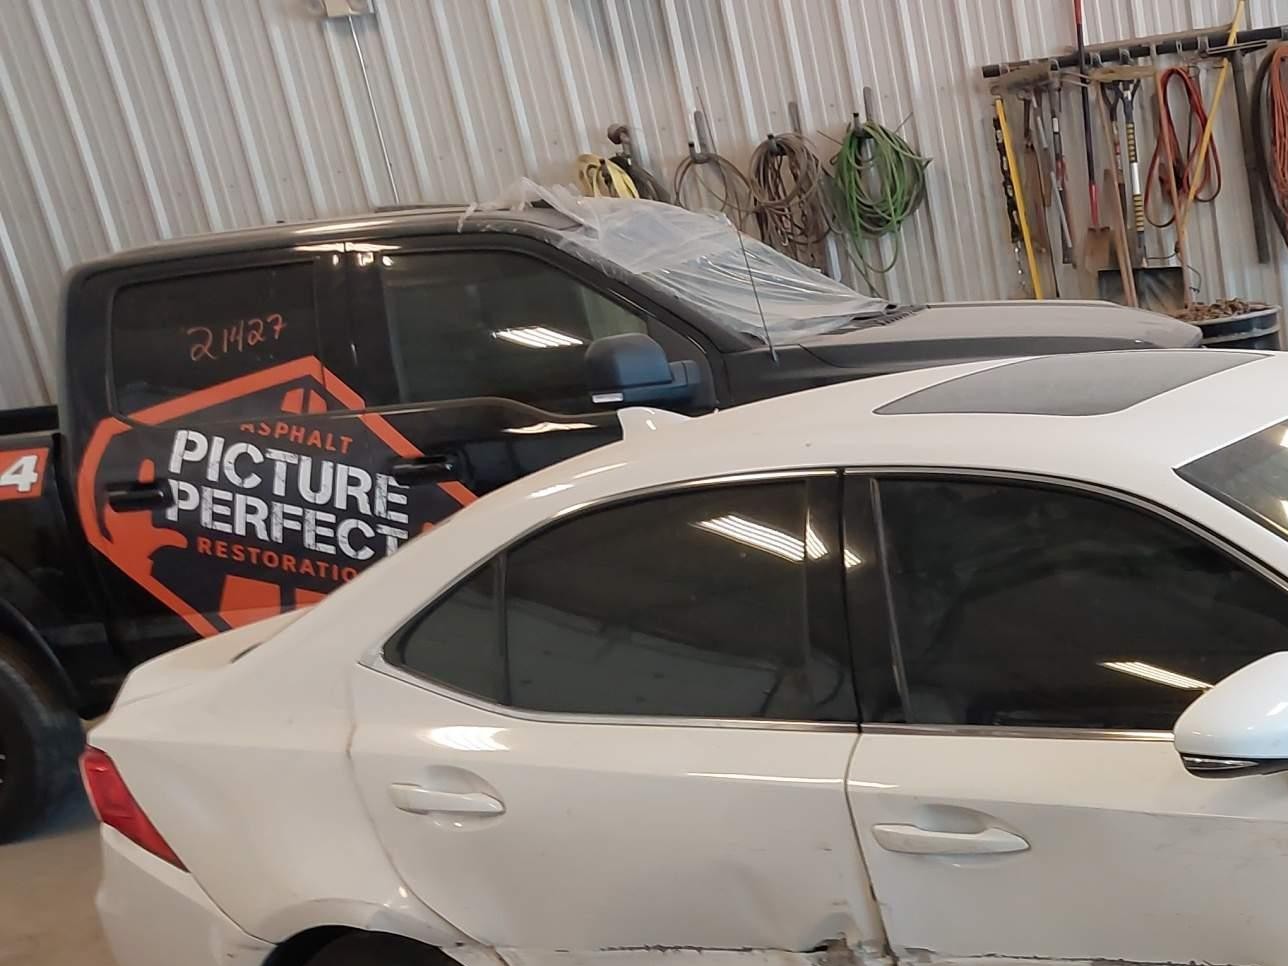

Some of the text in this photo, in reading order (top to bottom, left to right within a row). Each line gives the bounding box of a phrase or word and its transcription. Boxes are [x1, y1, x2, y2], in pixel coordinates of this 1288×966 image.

[186, 313, 287, 361] 21427
[0, 454, 39, 492] 4
[167, 429, 411, 524] PICTURE
[165, 479, 409, 561] PERFECT
[196, 536, 359, 583] RESTORATIO
